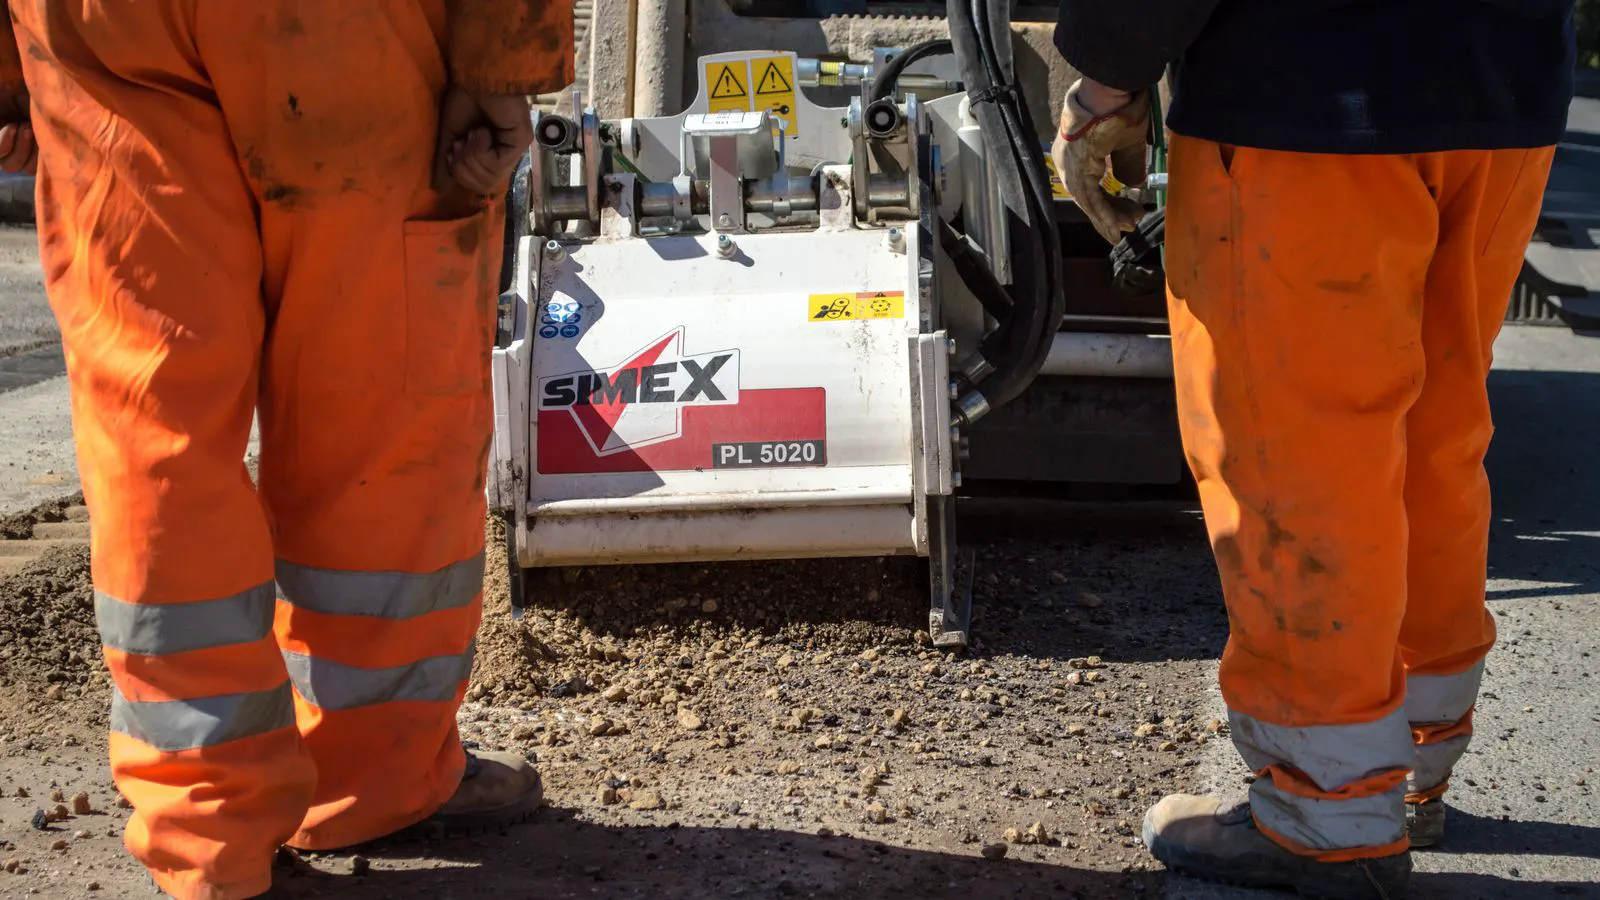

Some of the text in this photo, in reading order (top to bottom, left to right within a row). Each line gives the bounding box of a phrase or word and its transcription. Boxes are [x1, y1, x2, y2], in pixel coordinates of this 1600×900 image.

[542, 354, 733, 407] SIMEX
[720, 443, 816, 464] PL 5020
